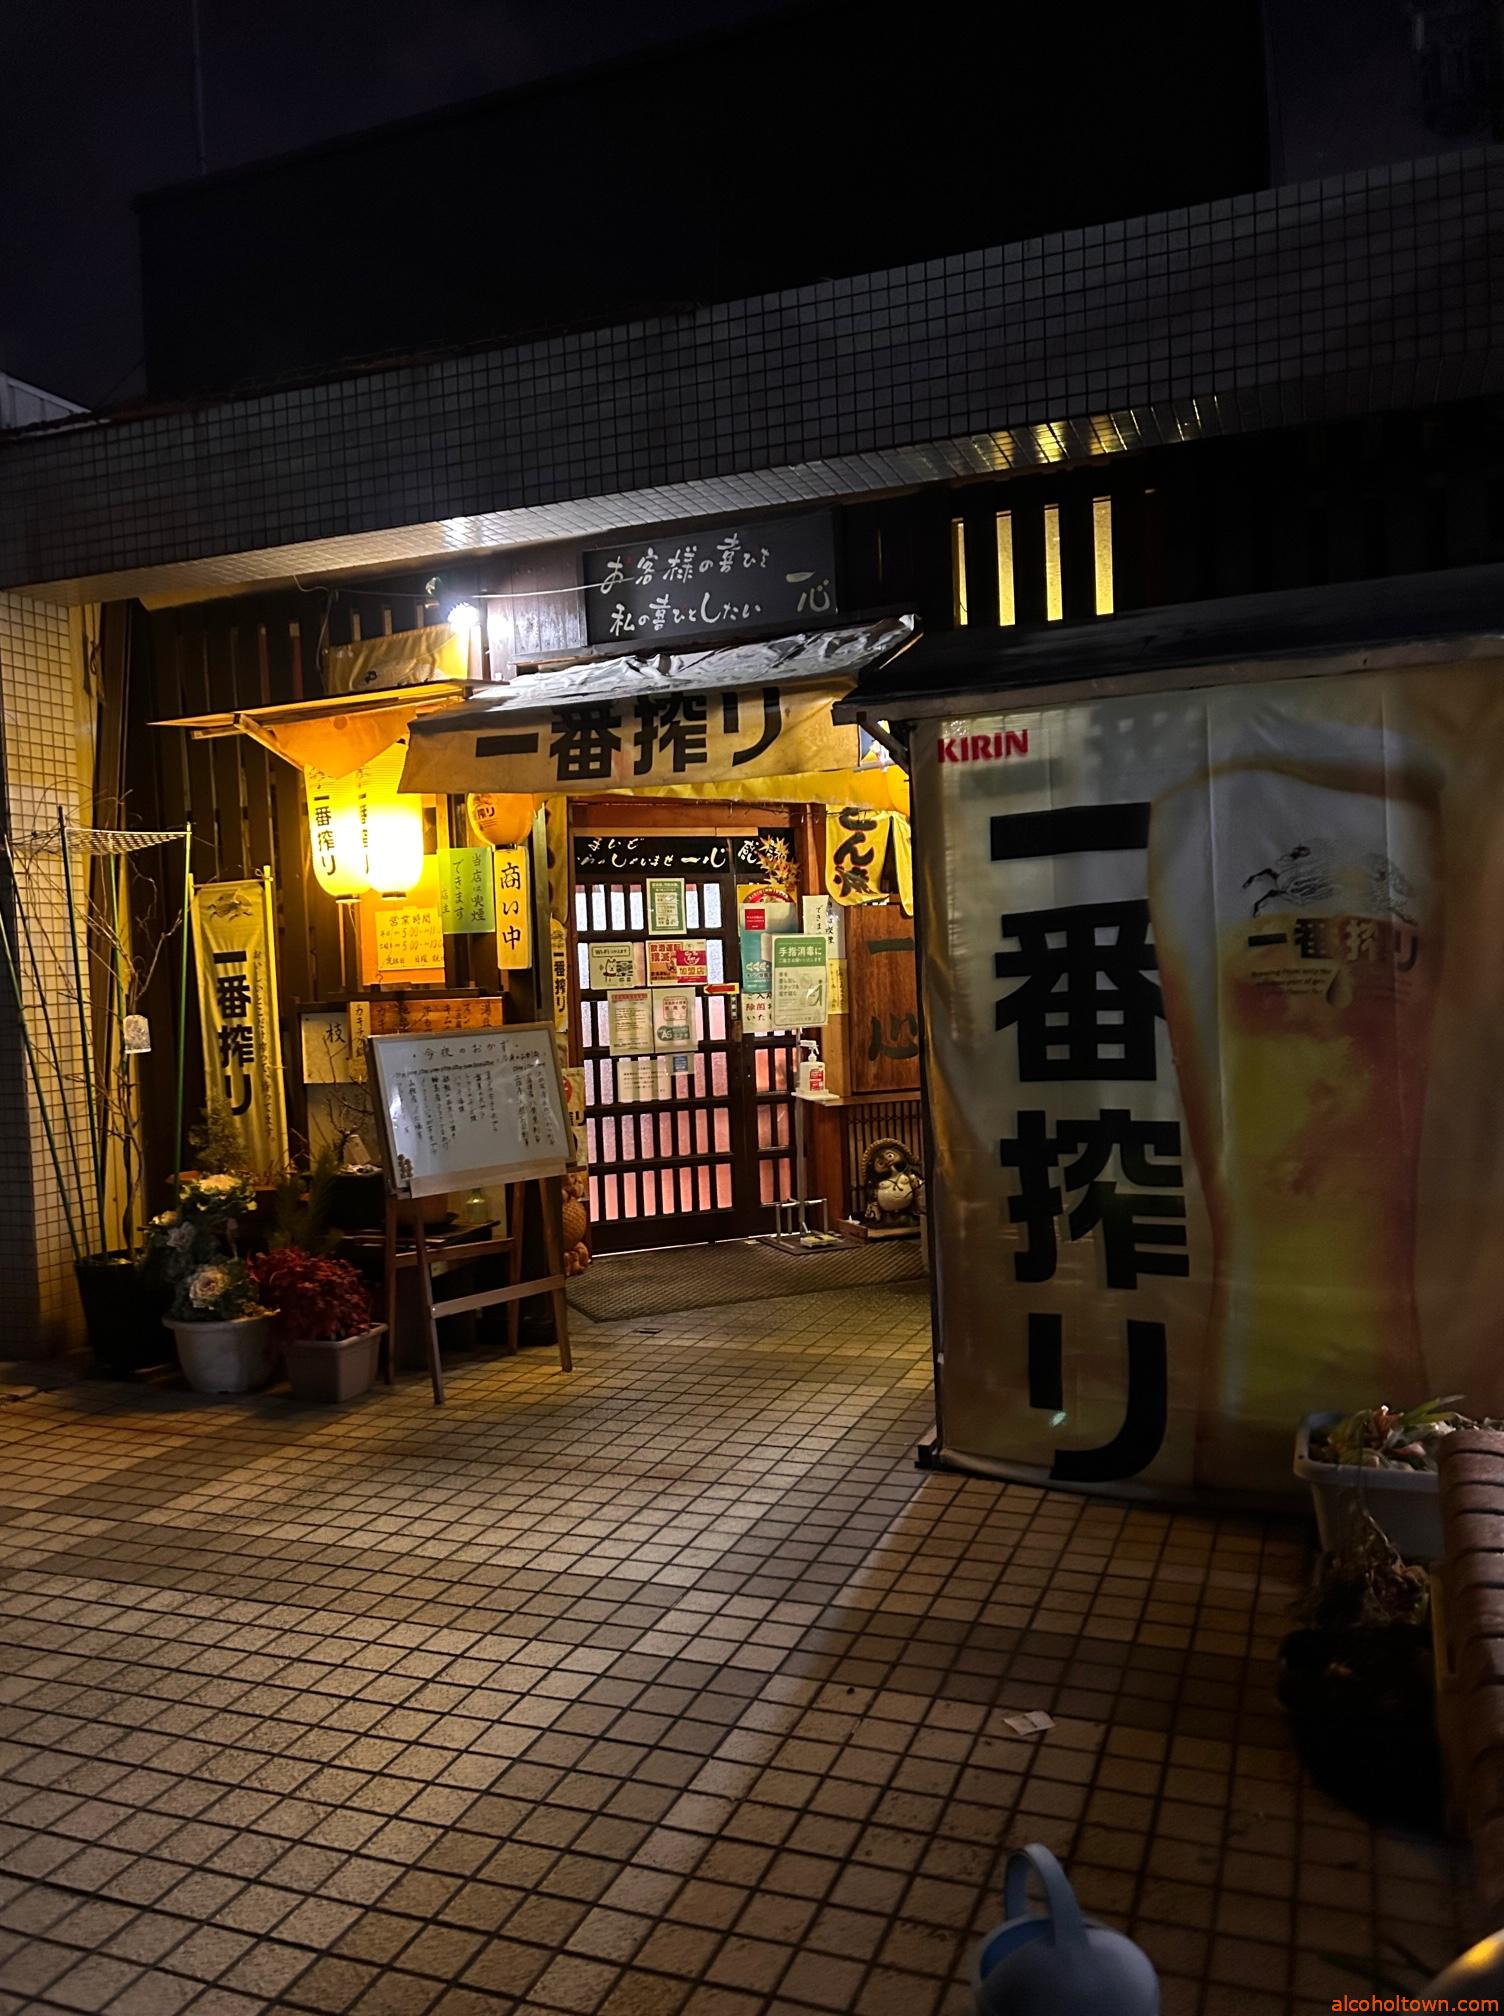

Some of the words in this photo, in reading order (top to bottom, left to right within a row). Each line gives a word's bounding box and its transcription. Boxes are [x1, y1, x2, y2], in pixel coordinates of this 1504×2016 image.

[475, 686, 783, 781] 一番搾り
[937, 728, 1029, 763] KIRIN
[314, 795, 335, 876] 一番搾り
[453, 858, 465, 921] できます
[471, 853, 486, 922] 当店は喫煙
[500, 862, 521, 950] 商い中
[779, 946, 822, 957] 手指消毒に
[213, 951, 254, 1116] 一番搾り
[989, 801, 1190, 1483] 一番搾り
